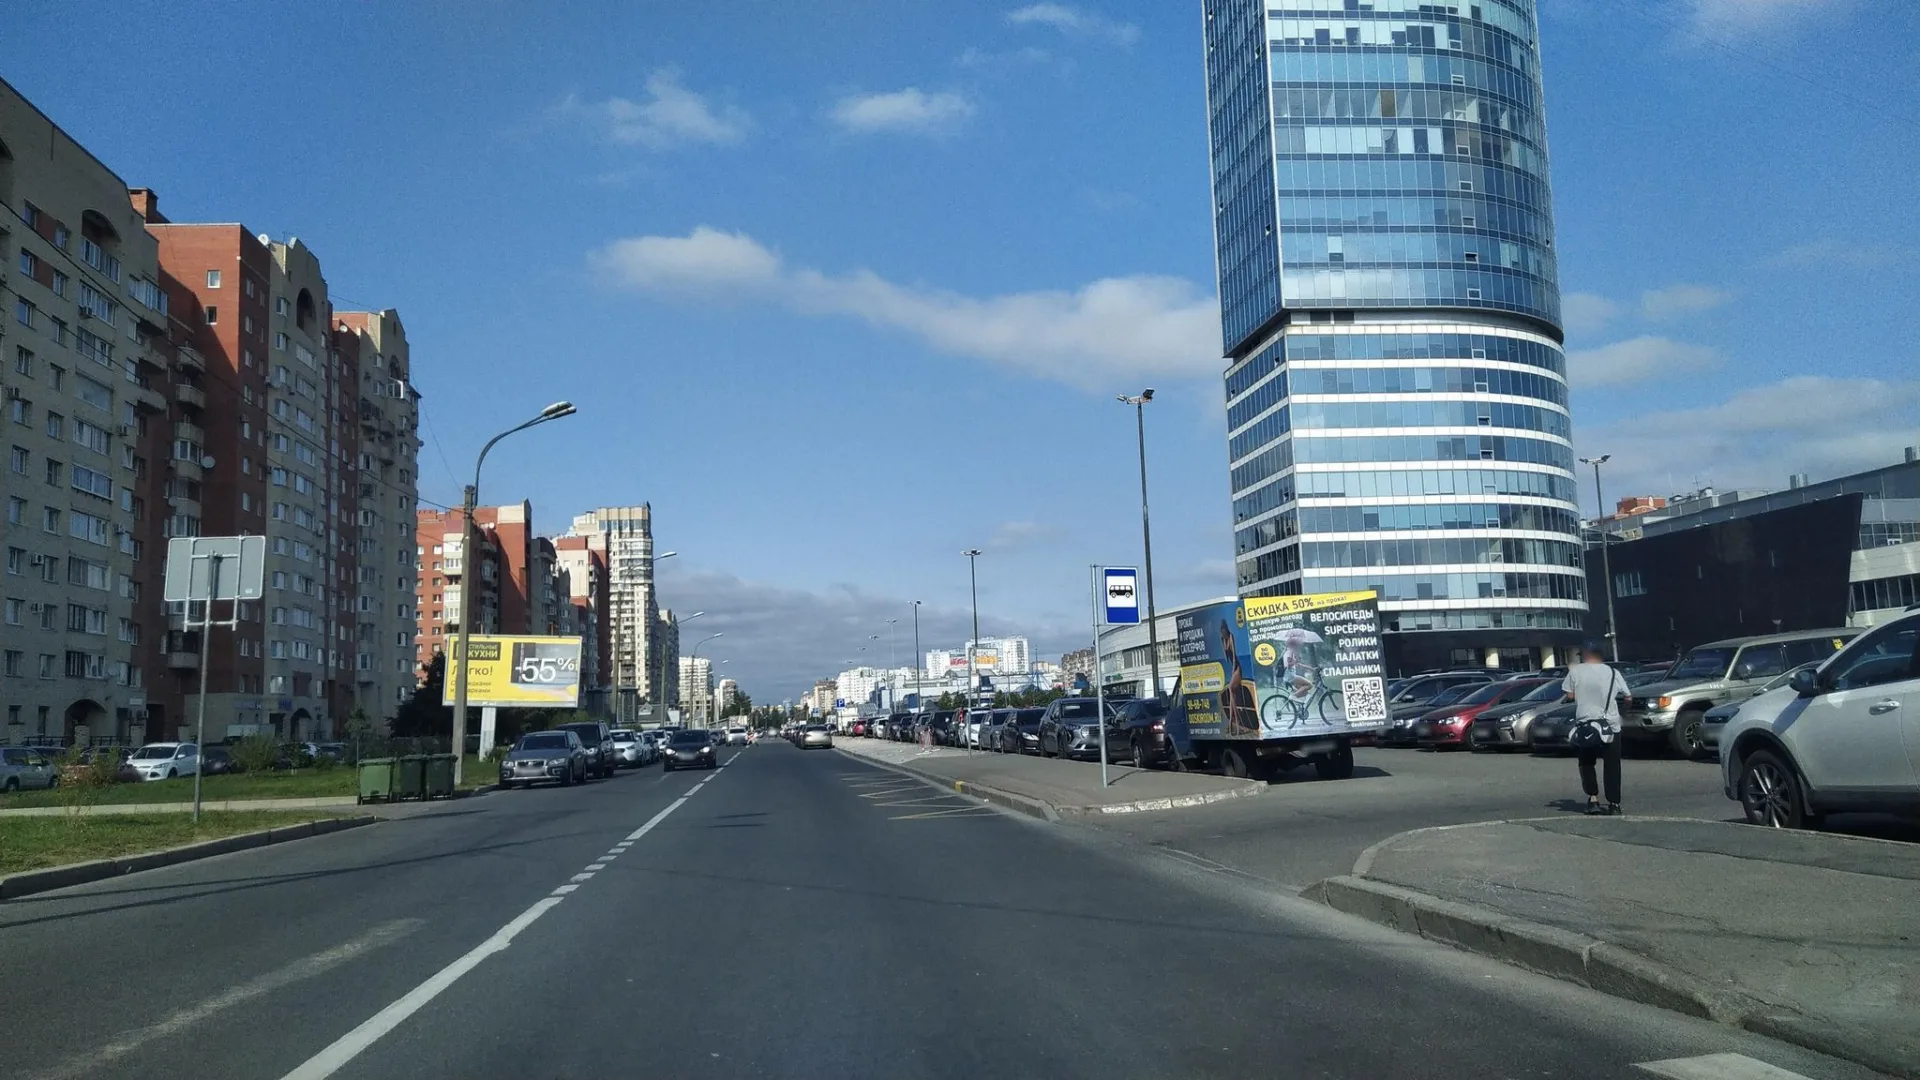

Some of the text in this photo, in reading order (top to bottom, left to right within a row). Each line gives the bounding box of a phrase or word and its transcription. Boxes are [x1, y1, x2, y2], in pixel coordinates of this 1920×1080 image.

[1247, 602, 1289, 618] СКИДКА
[1292, 597, 1314, 610] 50%
[1326, 595, 1347, 605] прокат
[1281, 612, 1303, 621] погоду
[1310, 609, 1374, 623] ВЕЛОСИПЕДЫ
[1178, 617, 1194, 629] ПРОКАТ
[1183, 628, 1205, 641] ПРОДАЖА
[1339, 636, 1377, 648] РОЛИКИ
[468, 650, 498, 658] КУХНИ
[1335, 650, 1379, 662] ПАЛАТКИ
[451, 665, 493, 676] Лгко!
[515, 657, 575, 682] -55%
[1323, 664, 1381, 677] СПАЛЬНИКИ
